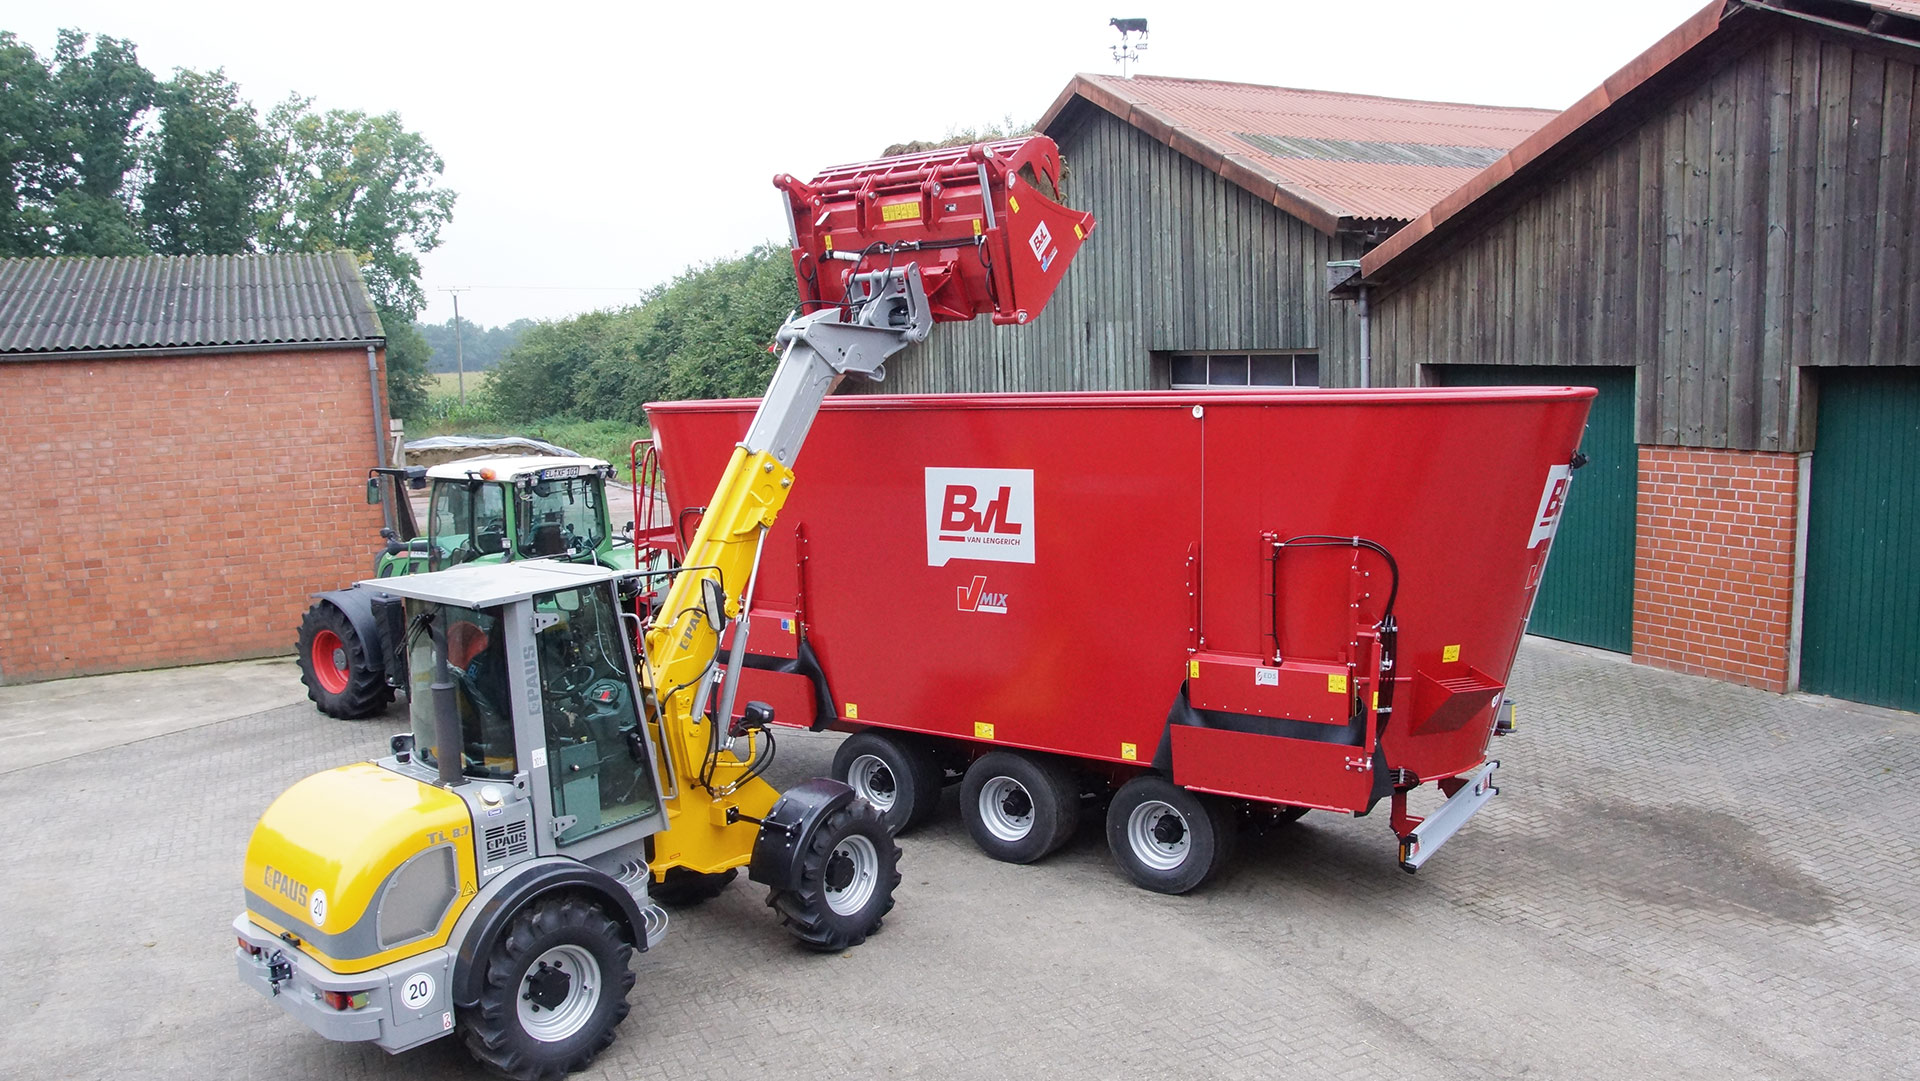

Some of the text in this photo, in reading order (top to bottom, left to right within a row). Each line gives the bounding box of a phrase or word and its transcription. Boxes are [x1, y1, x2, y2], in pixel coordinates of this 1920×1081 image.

[983, 537, 1021, 546] LENGERICH
[523, 645, 541, 701] PAUS
[426, 825, 469, 844] TL 8.7
[495, 831, 527, 849] PAUS
[272, 869, 308, 908] PAUS
[313, 897, 323, 916] 20
[409, 980, 428, 1000] 20
